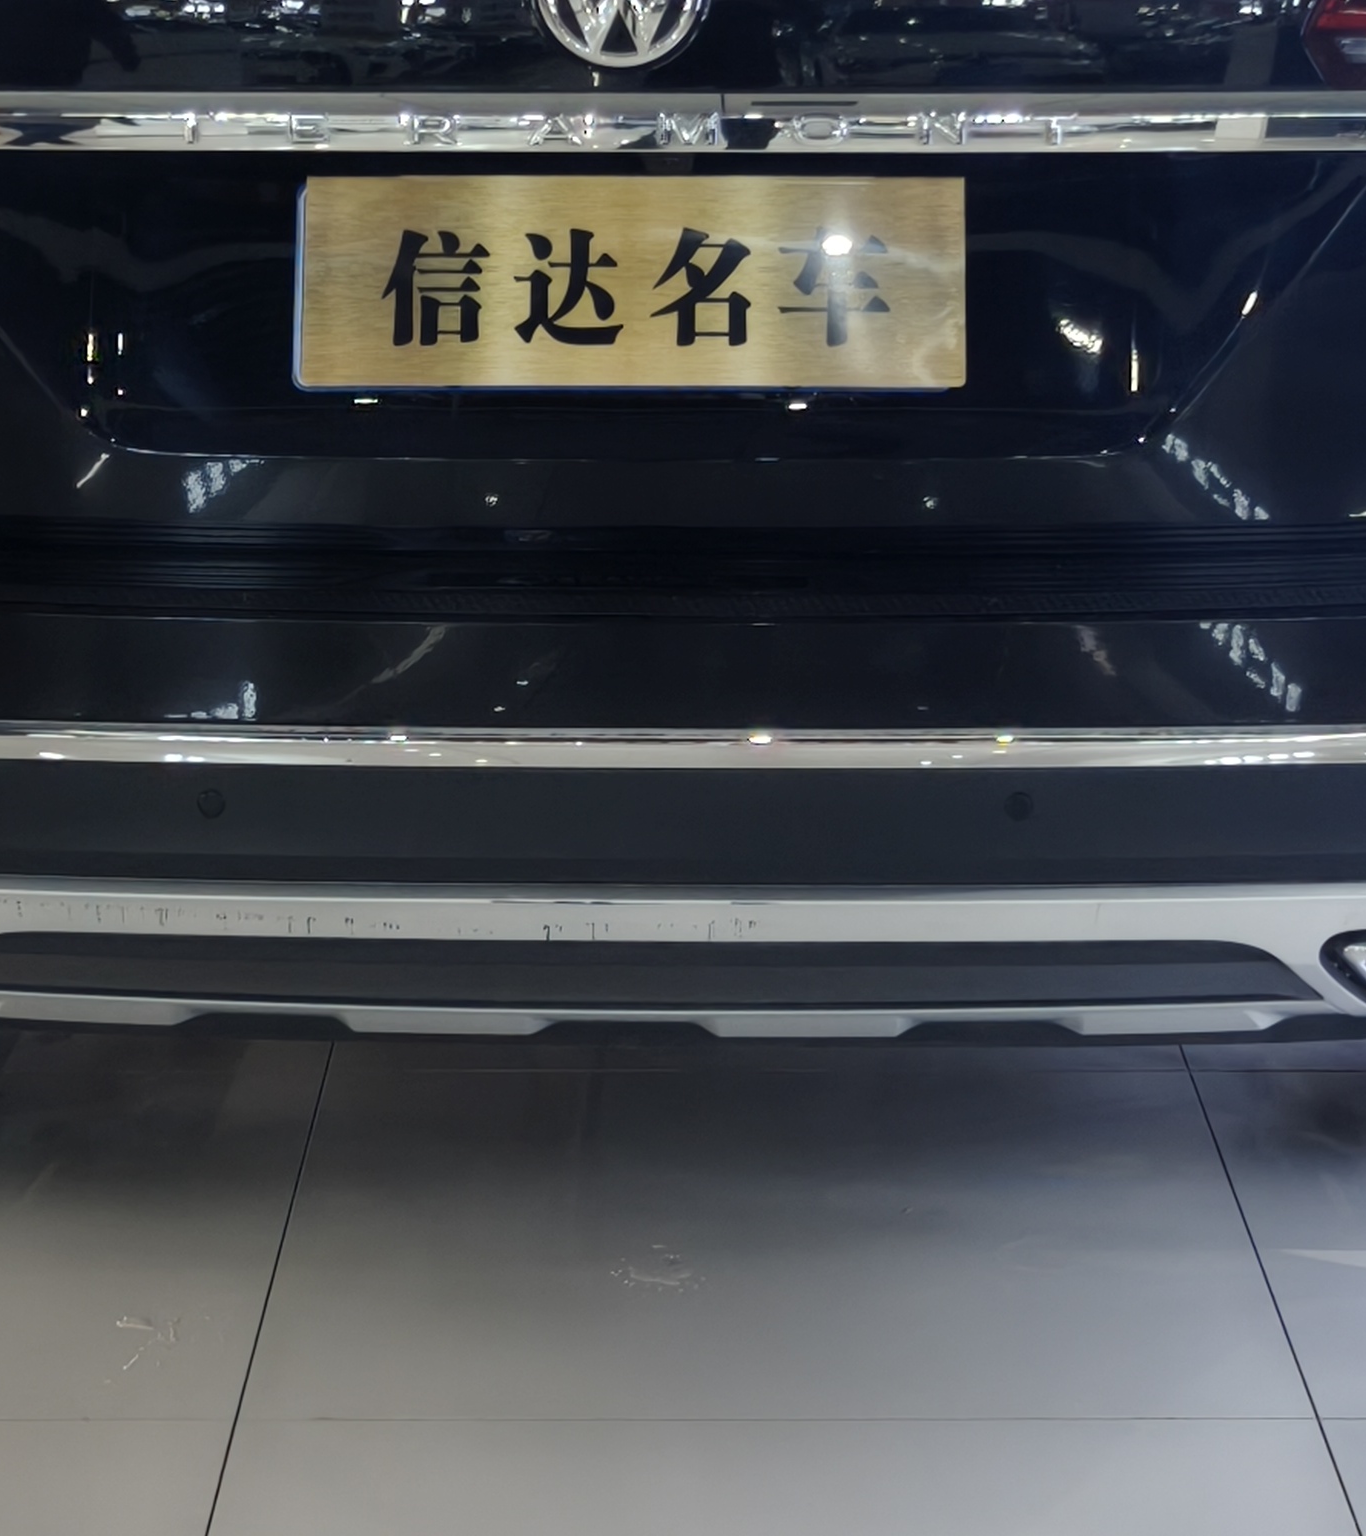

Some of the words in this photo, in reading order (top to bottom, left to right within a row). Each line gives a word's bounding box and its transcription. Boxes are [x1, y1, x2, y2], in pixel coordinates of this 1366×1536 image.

[172, 111, 1069, 147] TERAMONT
[382, 227, 891, 347] 信达名车
